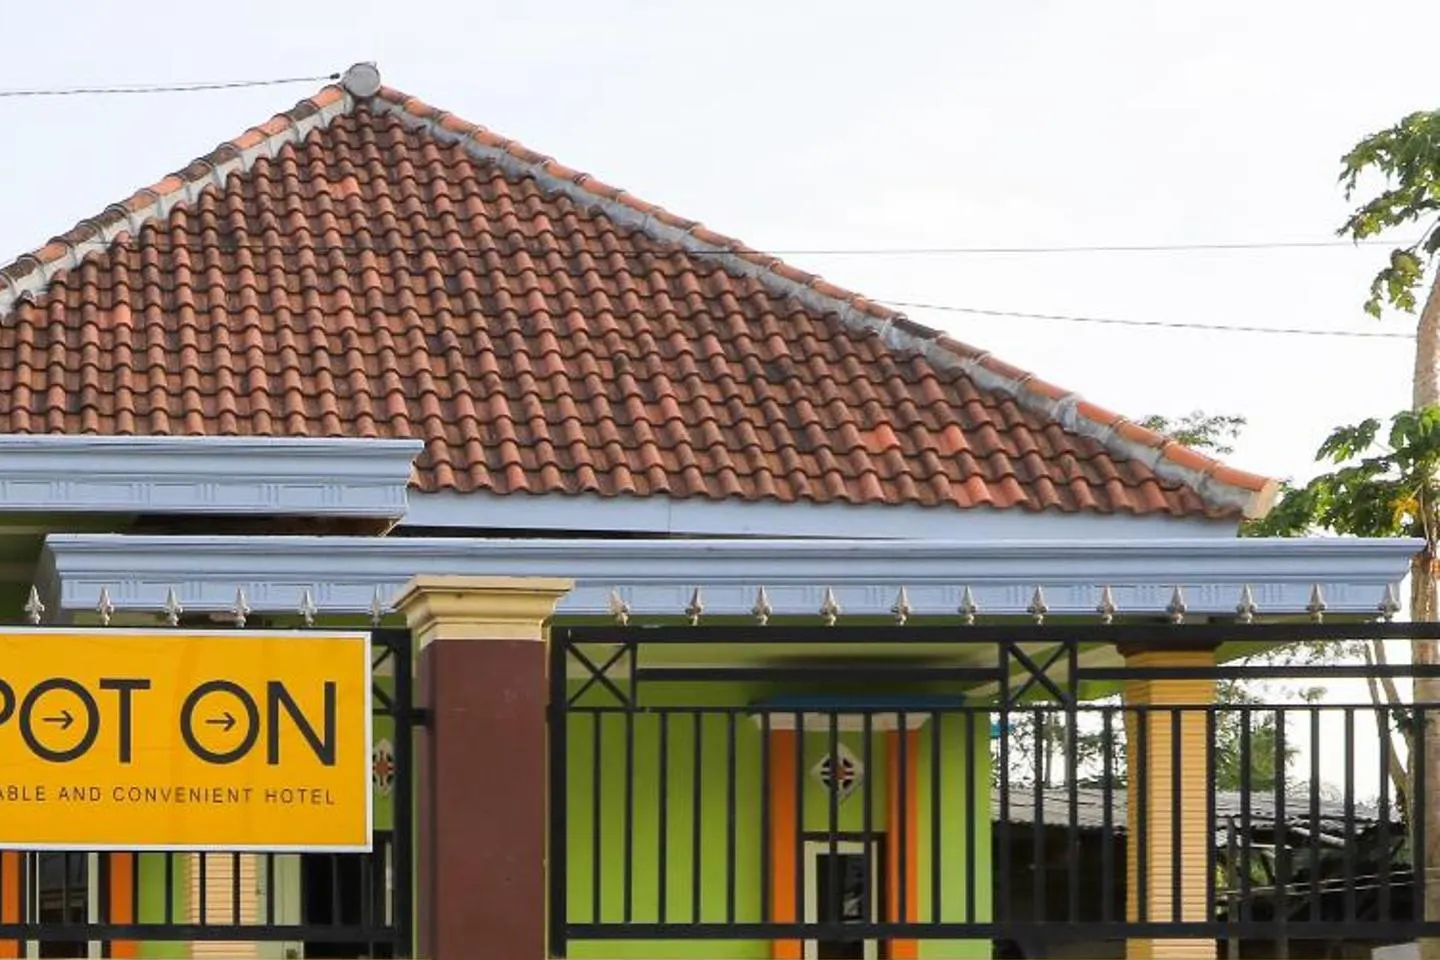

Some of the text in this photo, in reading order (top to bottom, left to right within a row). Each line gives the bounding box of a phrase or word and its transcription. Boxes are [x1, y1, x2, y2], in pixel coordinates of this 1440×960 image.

[179, 679, 337, 767] ON
[58, 786, 101, 802] AND
[112, 785, 253, 804] CONVENIENT
[264, 787, 336, 806] HOTEL
